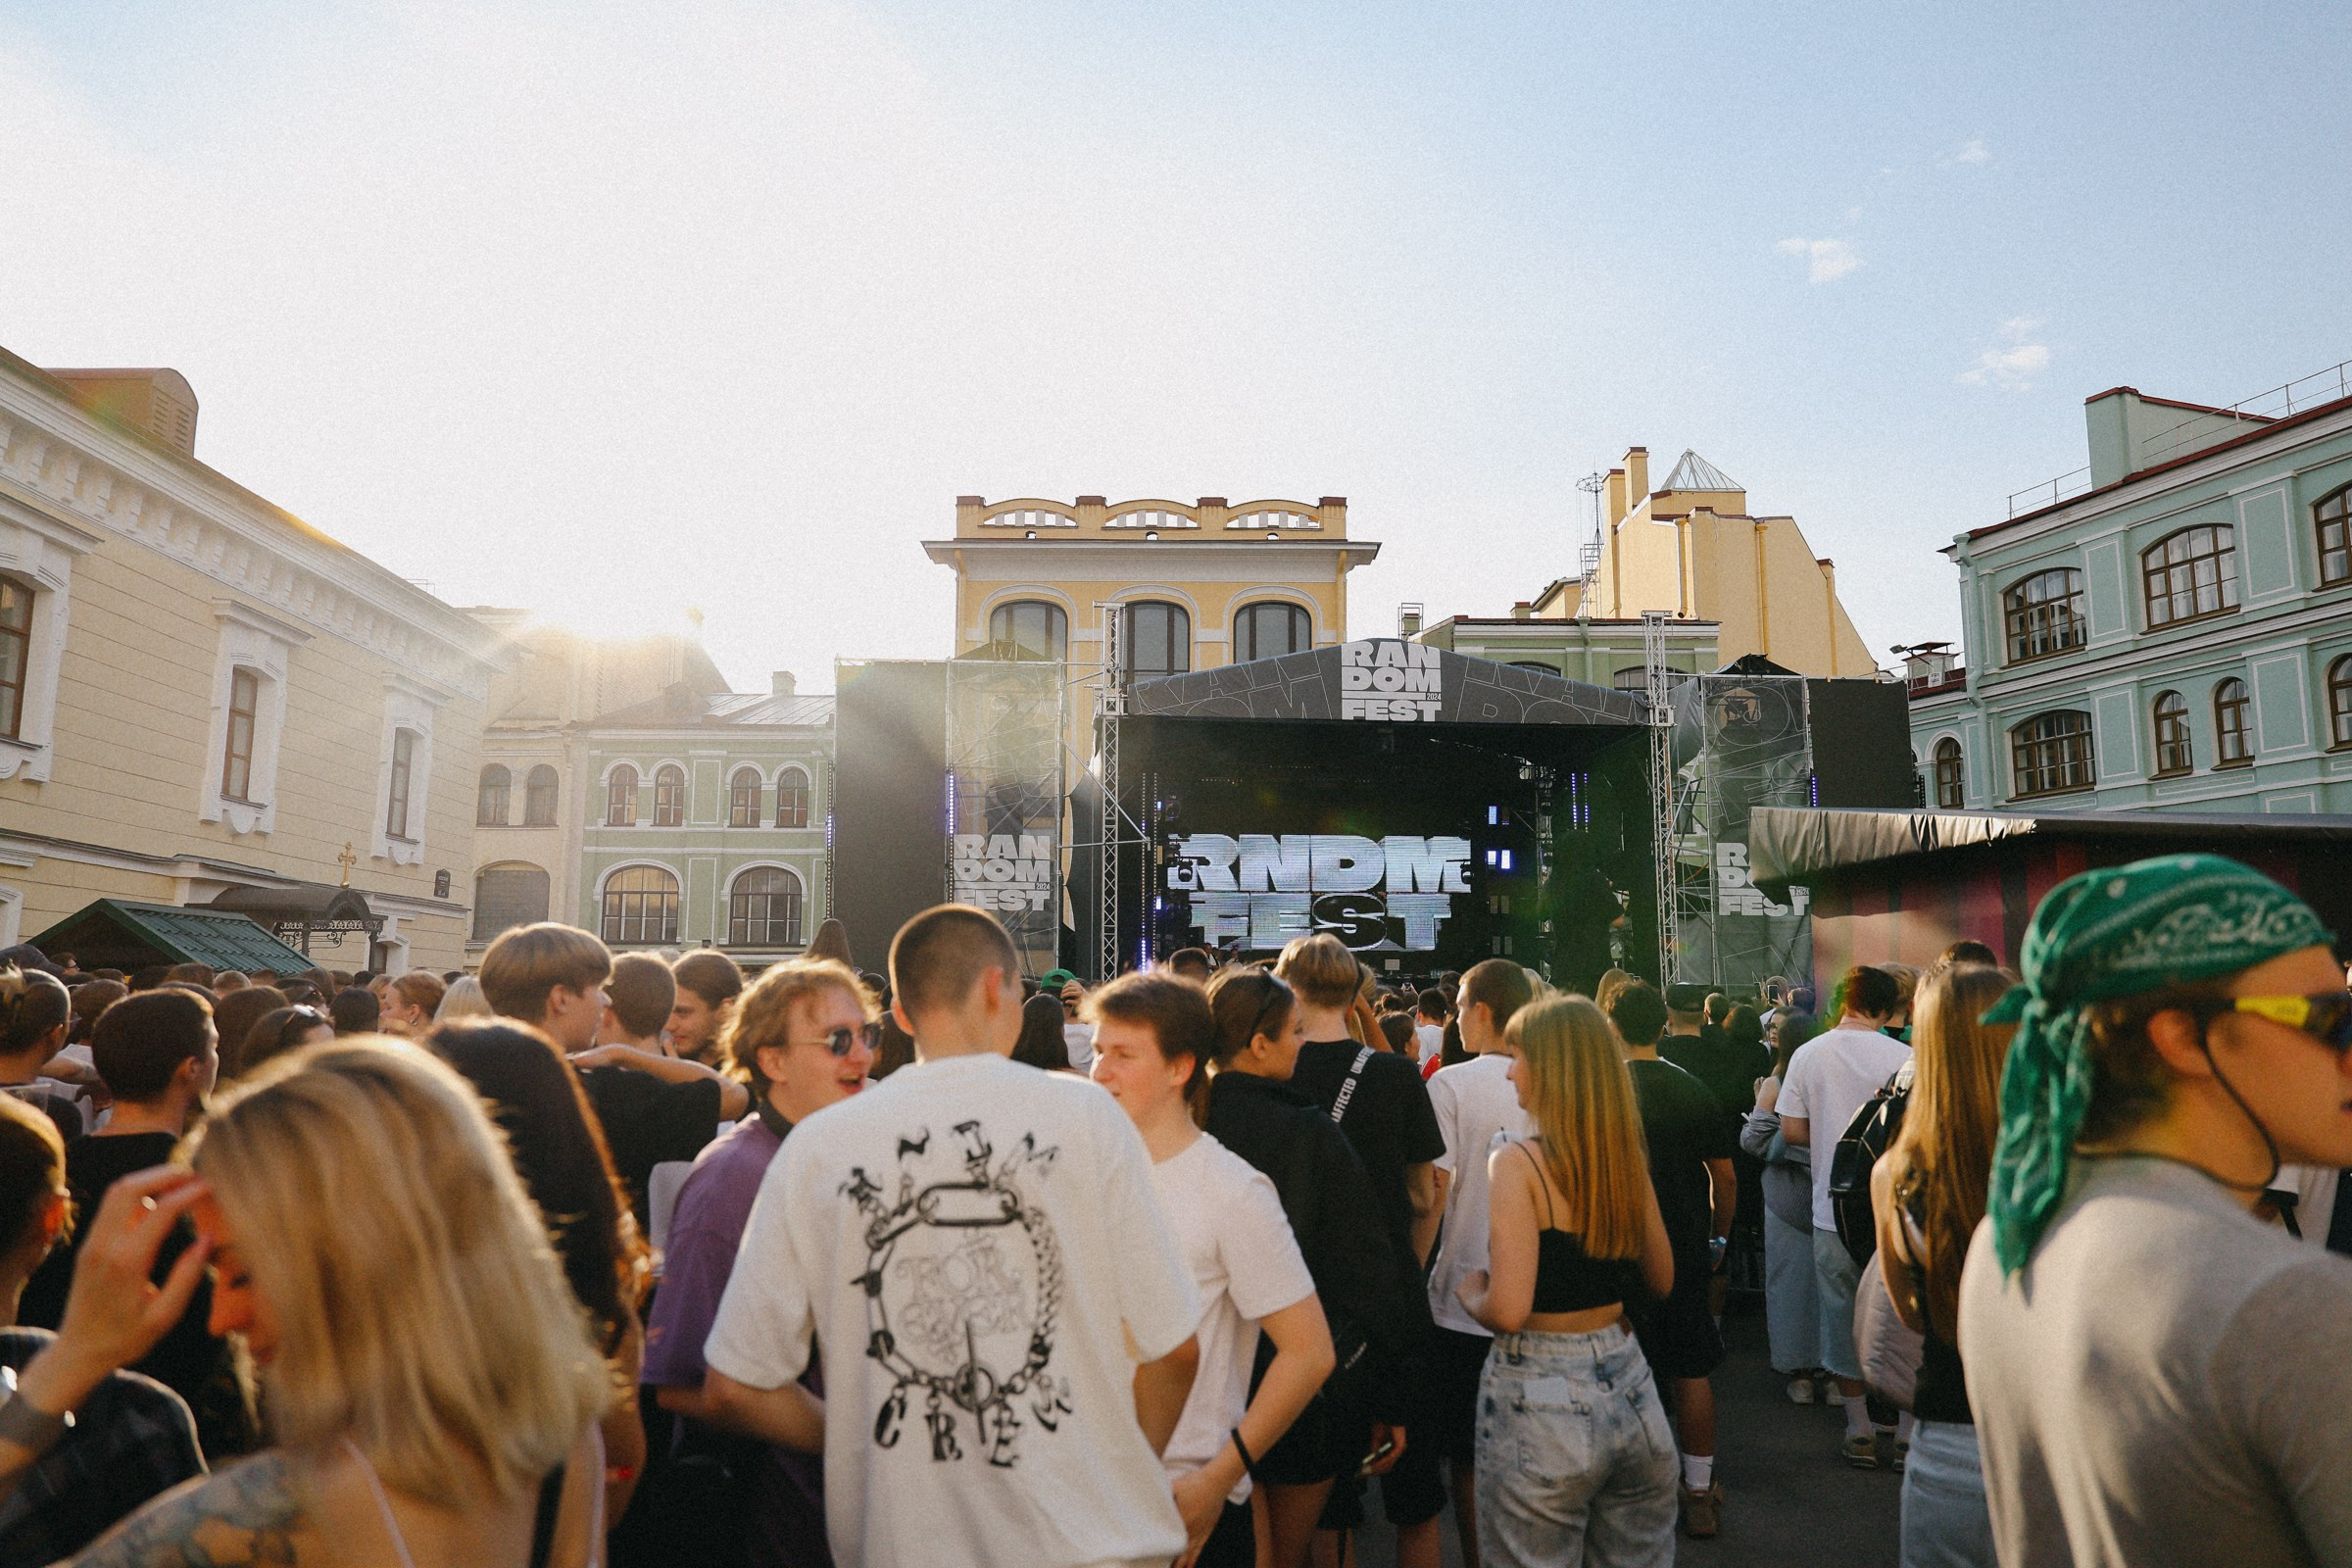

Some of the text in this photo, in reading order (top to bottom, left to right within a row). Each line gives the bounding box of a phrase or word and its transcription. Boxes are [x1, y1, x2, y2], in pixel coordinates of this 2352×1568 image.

[1342, 641, 1441, 668] RAN
[1342, 666, 1442, 692] DOM
[1342, 700, 1442, 721] FEST
[954, 834, 1051, 859] RAN
[954, 858, 1051, 882] DOM
[1167, 834, 1471, 893] RNDM
[955, 889, 1051, 910] FEST
[1189, 893, 1451, 951] FEST
